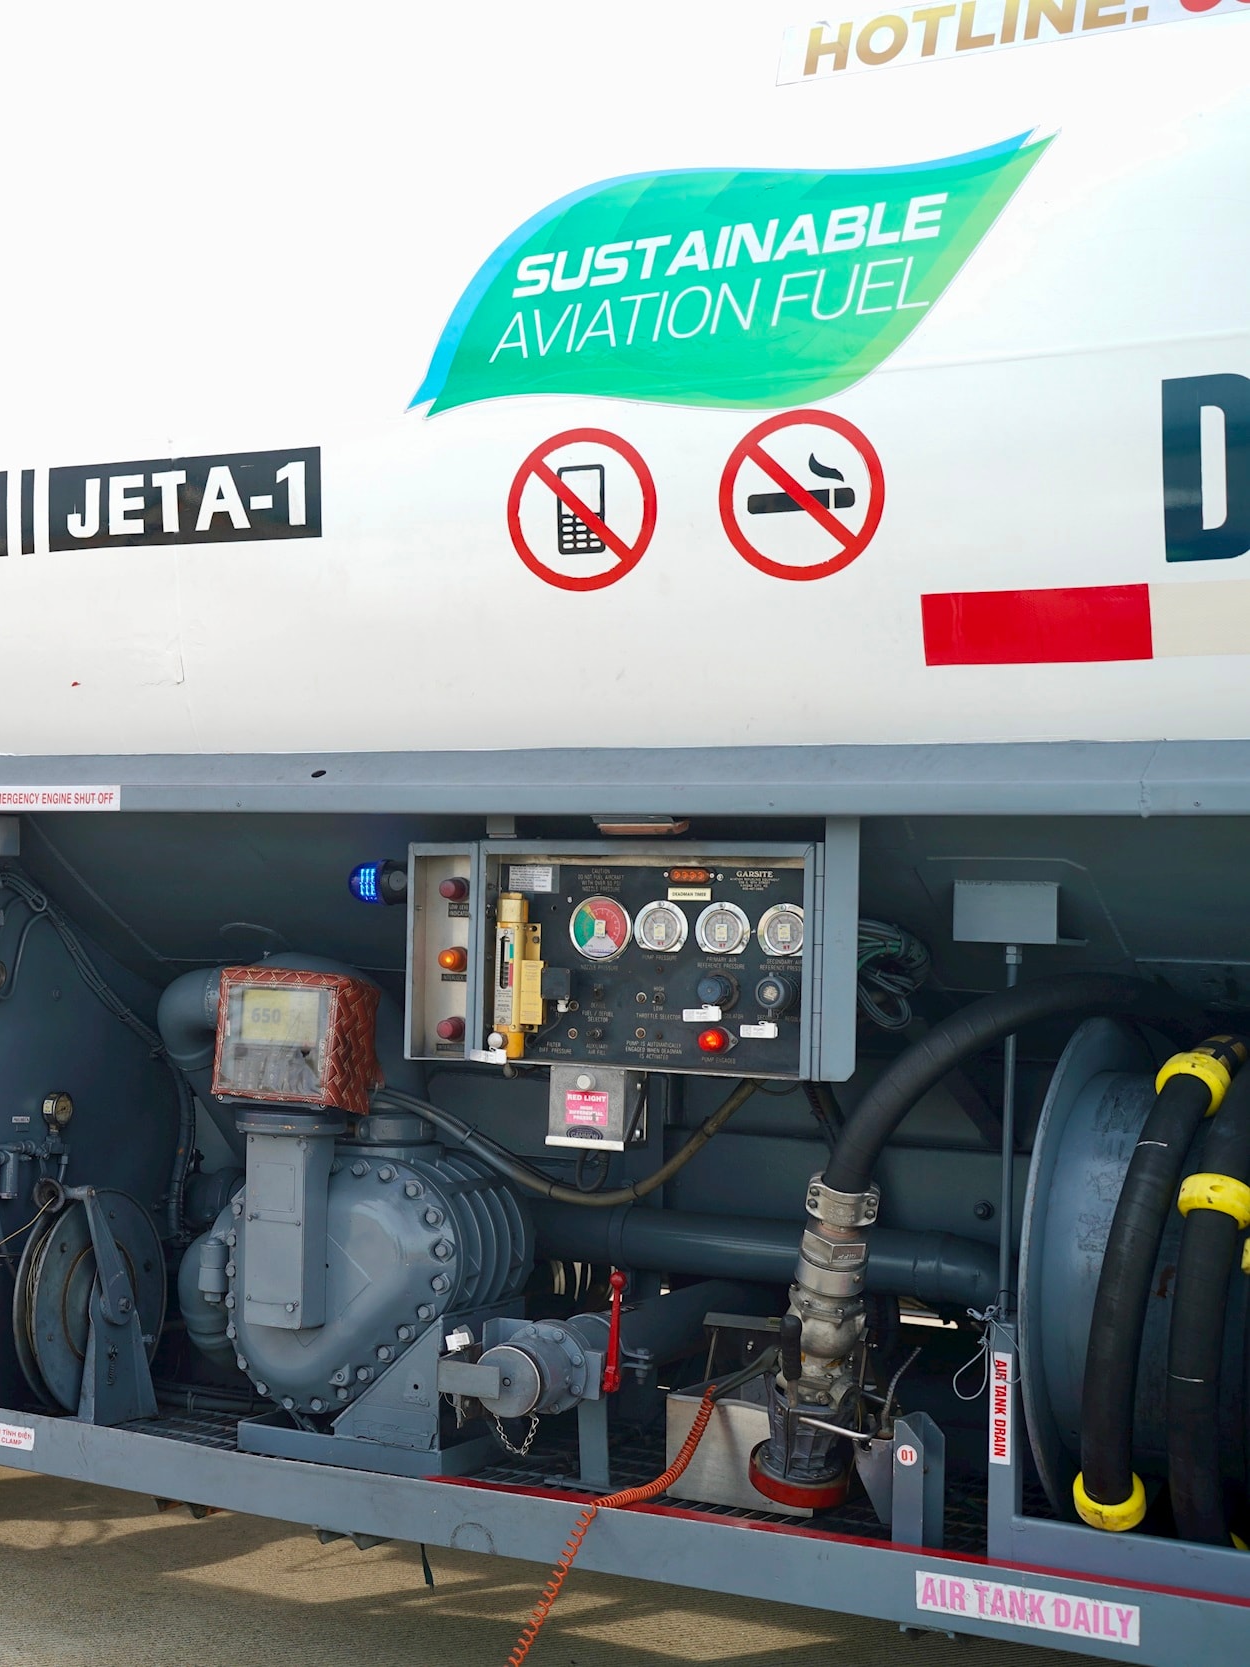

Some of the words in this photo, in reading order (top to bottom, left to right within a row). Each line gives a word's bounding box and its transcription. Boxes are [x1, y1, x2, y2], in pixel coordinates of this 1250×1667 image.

[512, 193, 948, 298] SUSTAINABLE
[489, 276, 763, 363] AVIATION
[771, 257, 930, 326] FUEL
[41, 793, 72, 804] ENGINE
[74, 793, 96, 804] SHUT
[98, 793, 114, 804] OFF
[736, 870, 774, 878] GARSITE
[251, 1007, 282, 1024] 650
[995, 1360, 1007, 1380] AIR
[994, 1385, 1007, 1415] TANK
[2, 1437, 22, 1445] CLAMP
[994, 1419, 1006, 1457] DRAIN
[901, 1449, 913, 1461] 01
[921, 1577, 966, 1612] AIR
[973, 1584, 1046, 1625] TANK
[1054, 1598, 1133, 1639] DAILY
